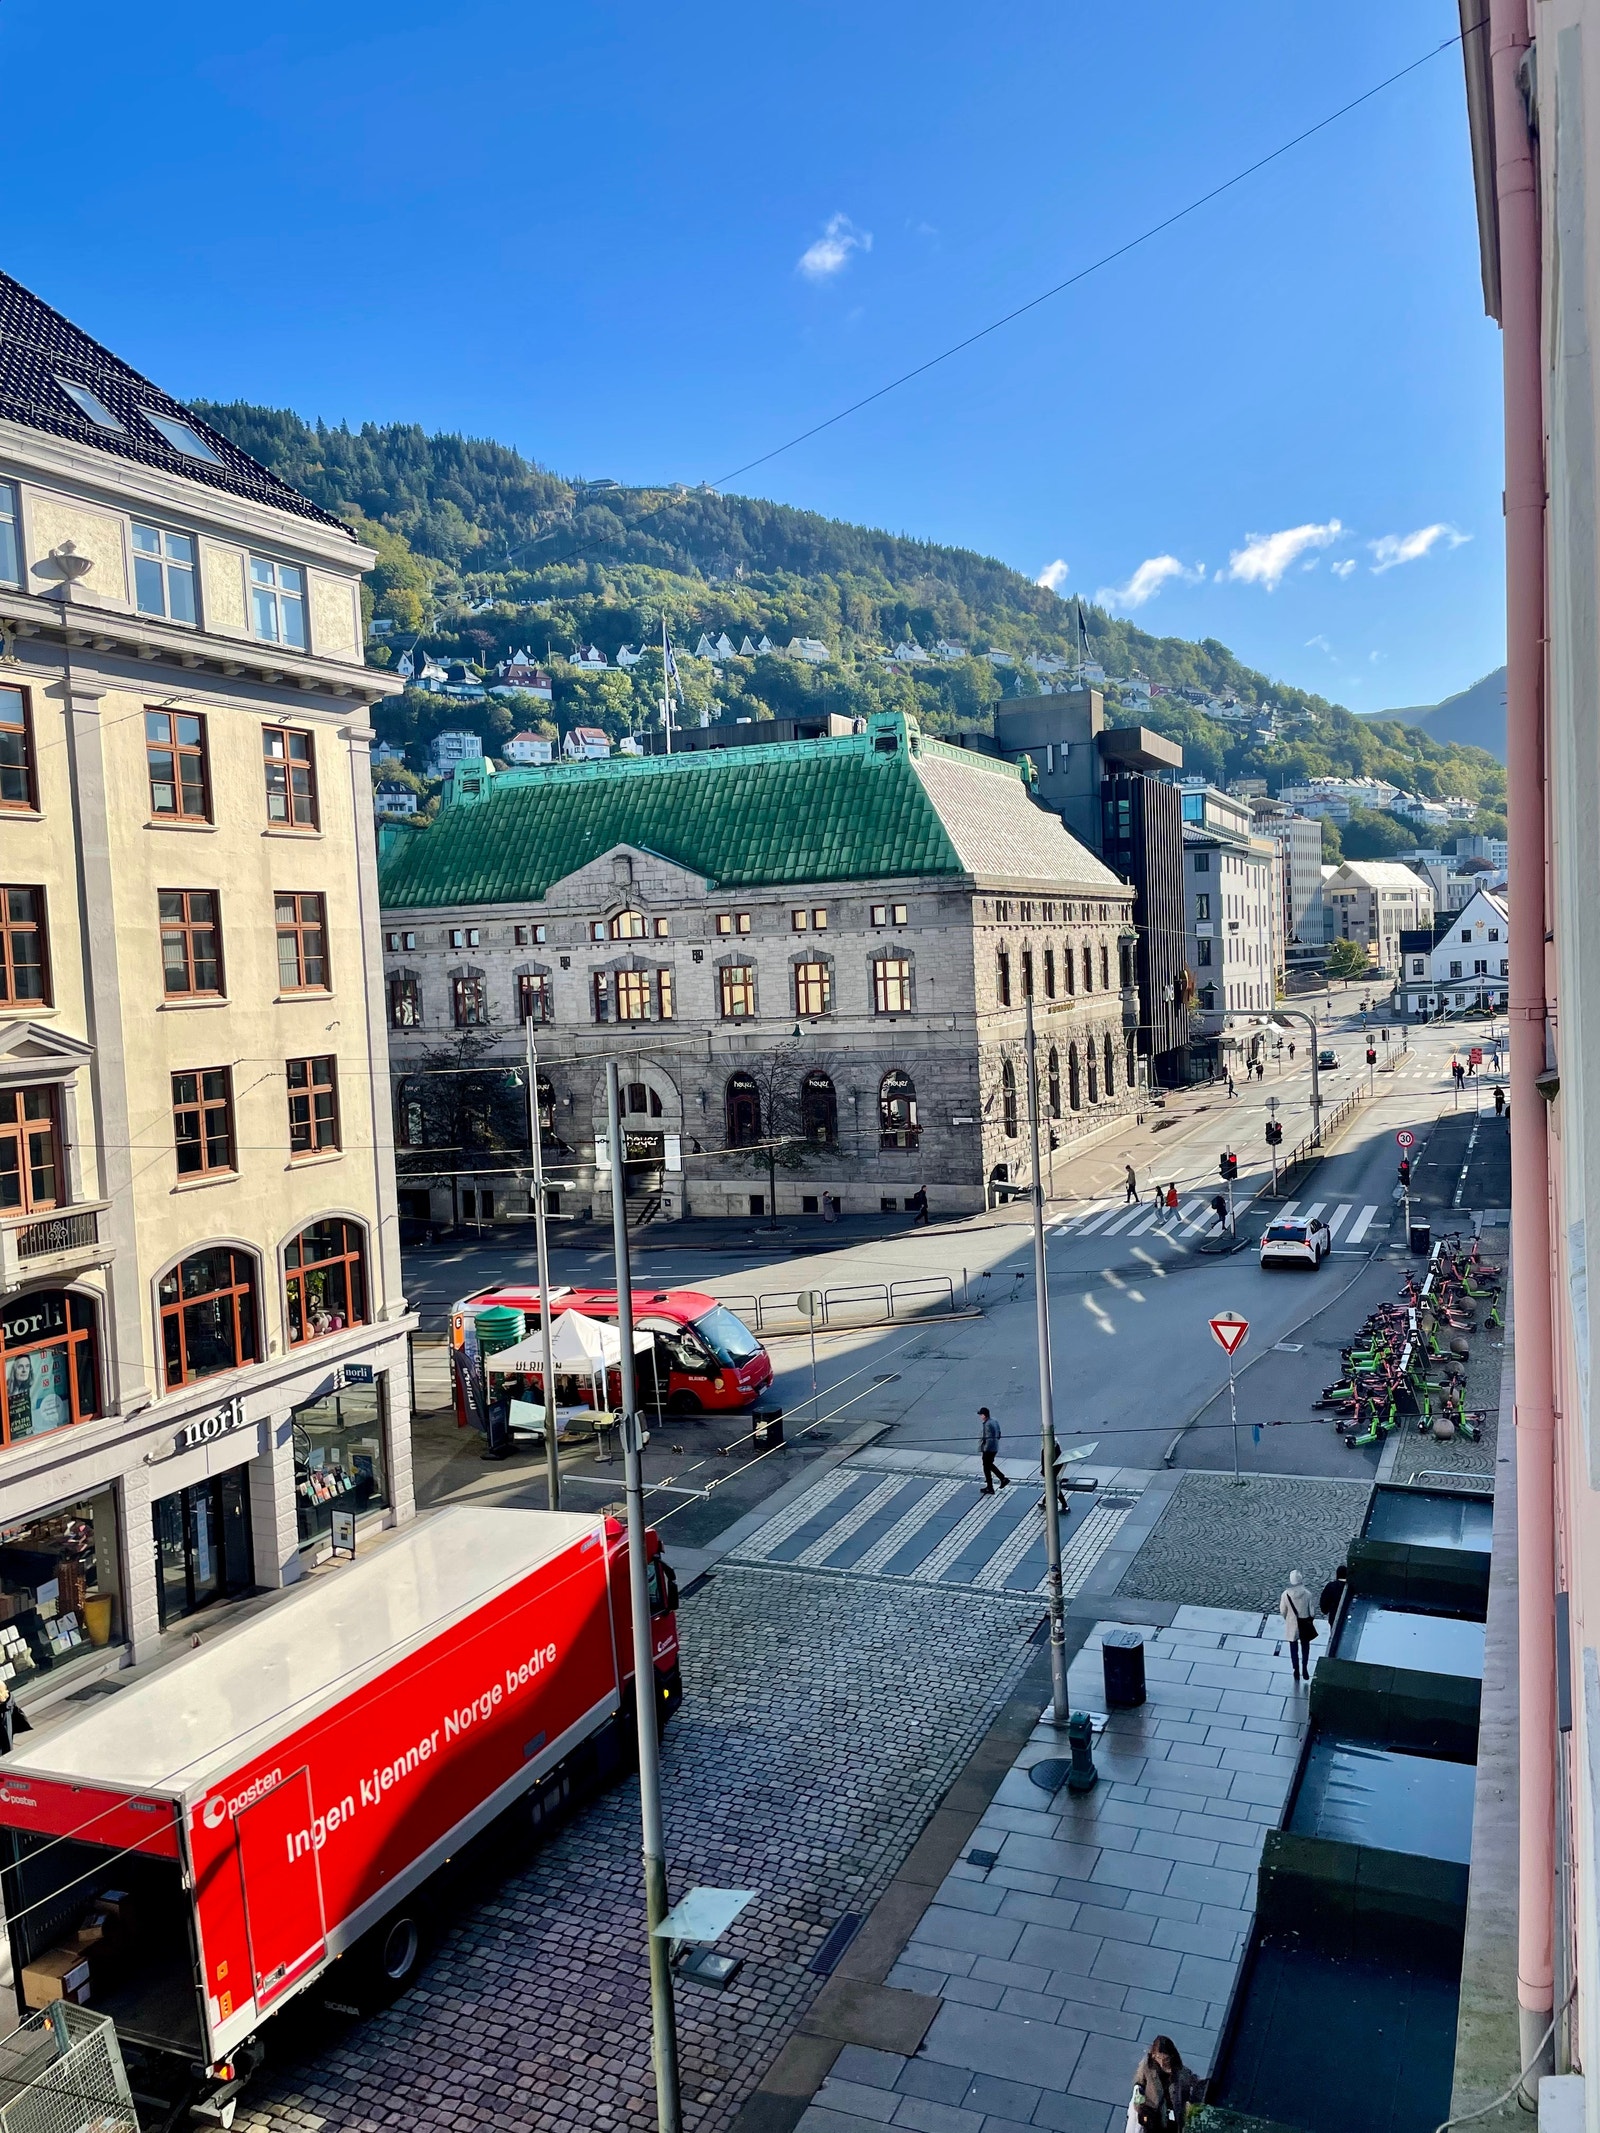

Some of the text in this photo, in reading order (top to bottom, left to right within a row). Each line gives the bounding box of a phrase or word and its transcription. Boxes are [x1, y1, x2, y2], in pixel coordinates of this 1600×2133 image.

[1400, 1134, 1411, 1143] 30
[345, 1367, 367, 1378] norli
[184, 1396, 248, 1447] norli
[286, 1642, 557, 1864] Ingen kjenner Norge bedre
[10, 1796, 38, 1808] posten
[228, 1767, 283, 1820] posten
